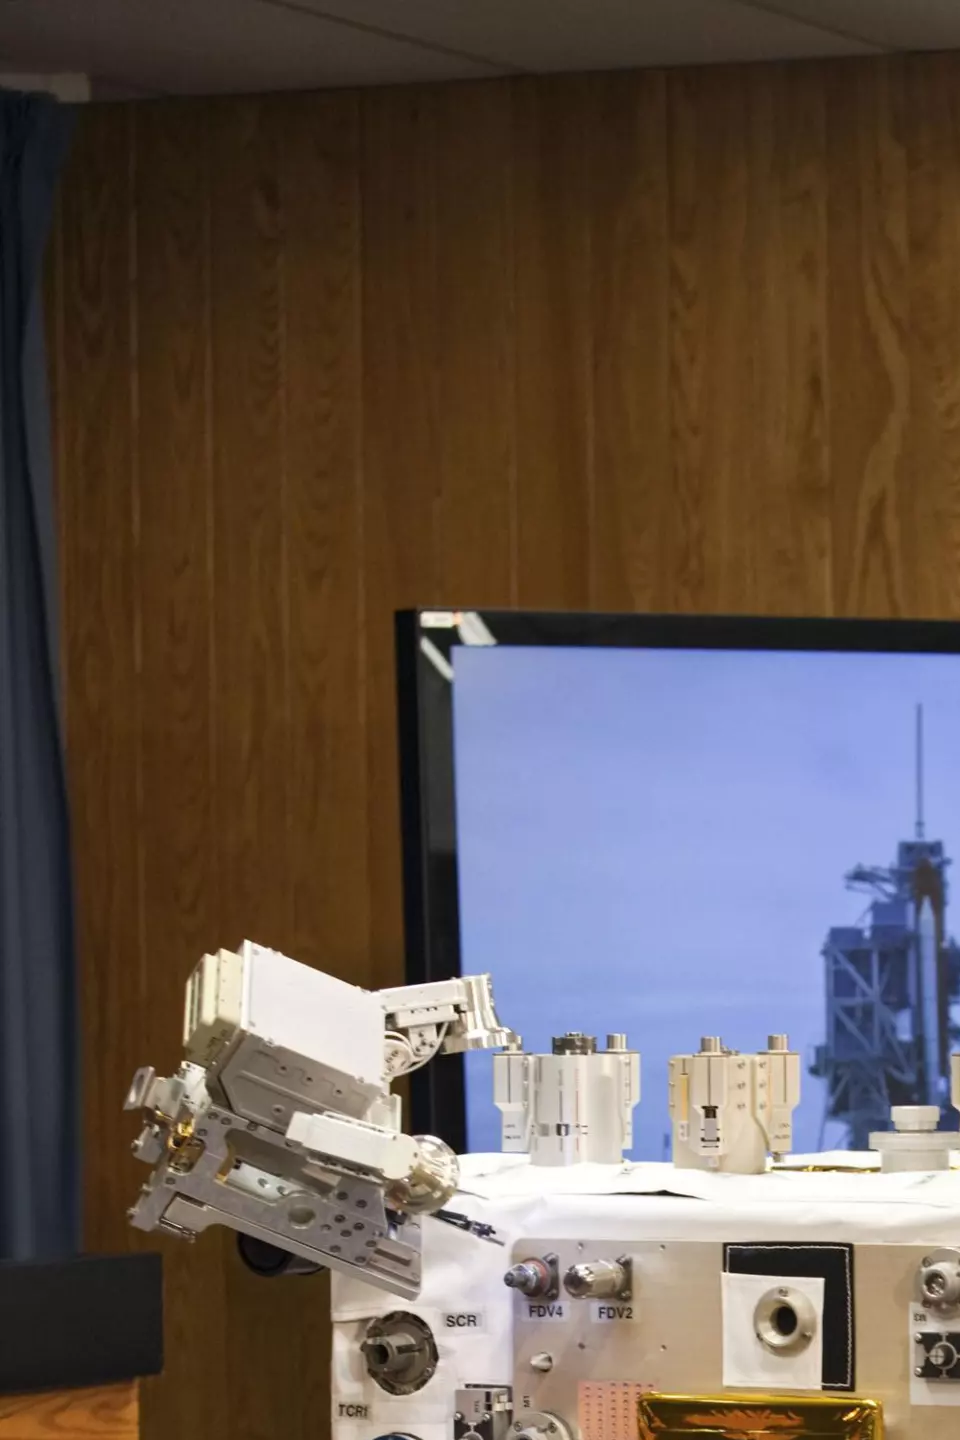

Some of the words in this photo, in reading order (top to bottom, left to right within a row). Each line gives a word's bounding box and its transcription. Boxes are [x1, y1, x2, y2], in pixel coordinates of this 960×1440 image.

[528, 1305, 563, 1318] FDV4
[598, 1306, 633, 1319] FDV2
[446, 1314, 477, 1328] SCR
[523, 1395, 532, 1408] M1
[338, 1403, 369, 1418] TCR1
